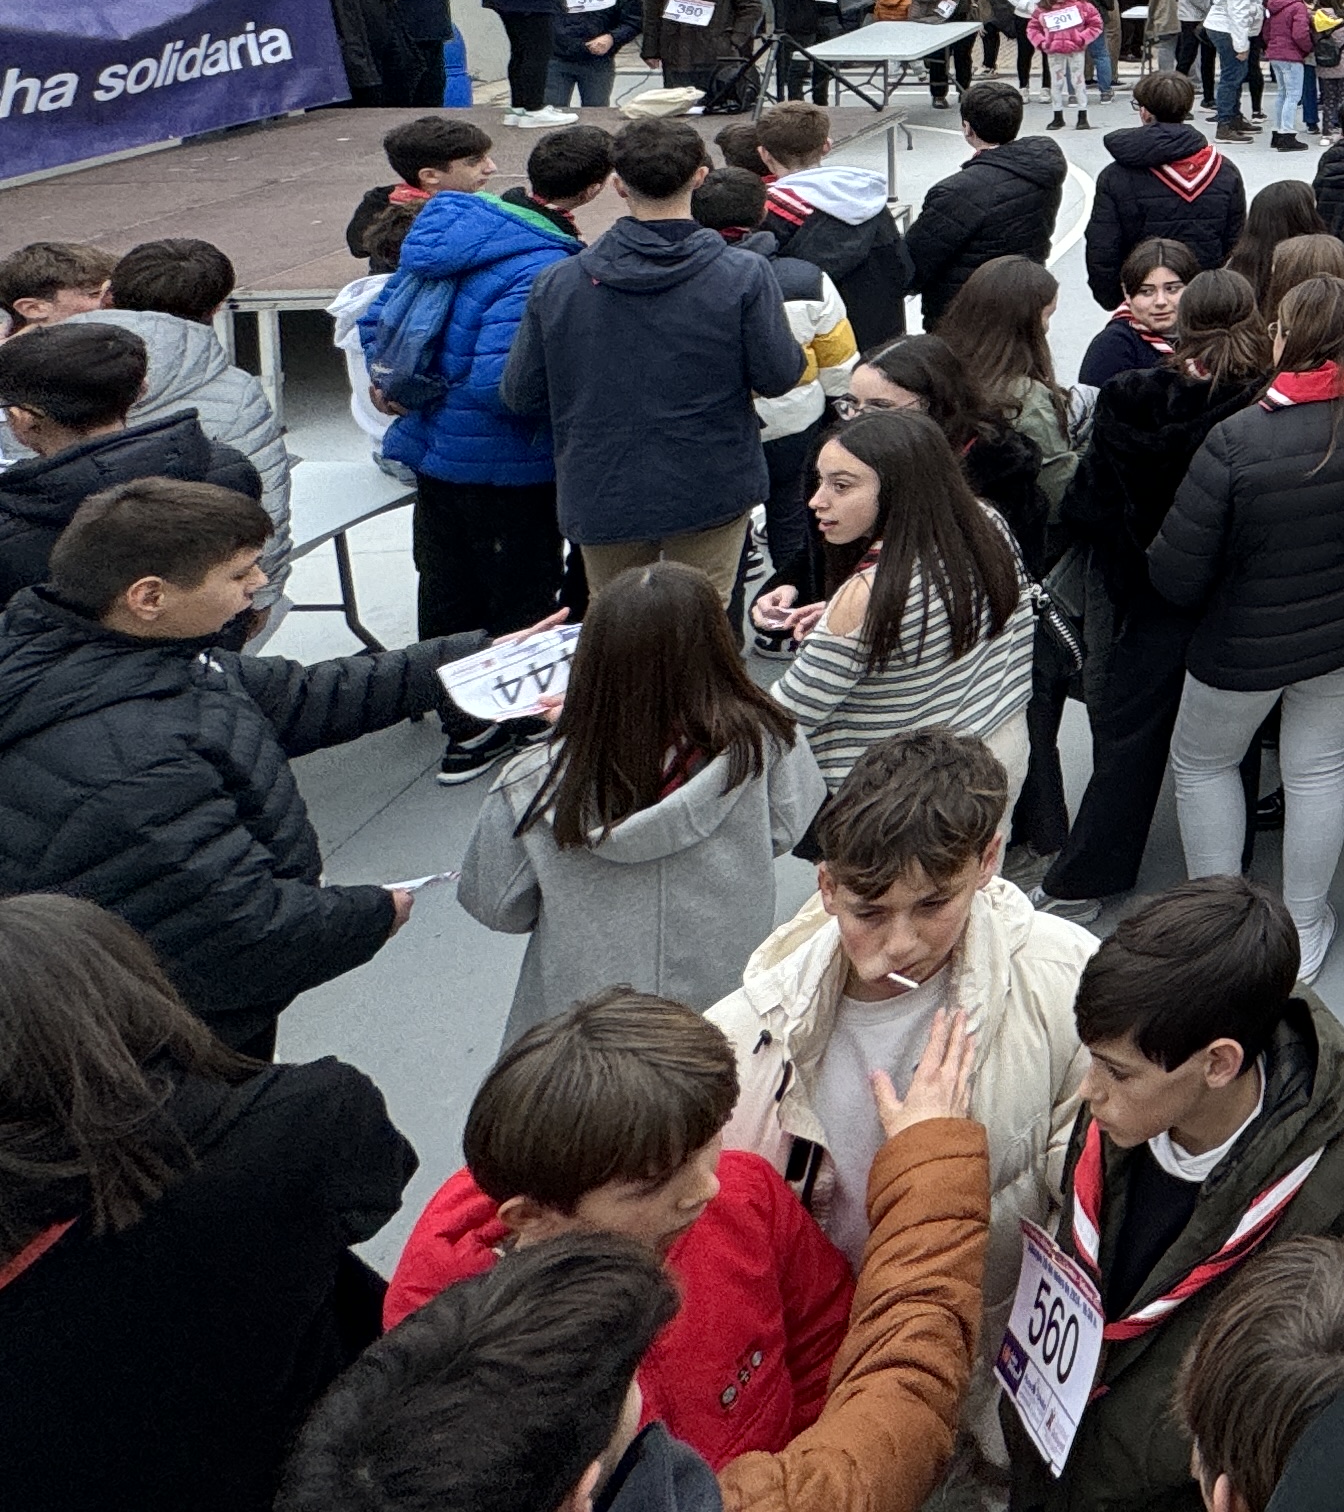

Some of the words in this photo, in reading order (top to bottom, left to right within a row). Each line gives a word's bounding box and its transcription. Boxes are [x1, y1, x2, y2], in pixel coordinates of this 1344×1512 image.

[676, 3, 703, 17] 380
[1053, 13, 1073, 26] 201
[93, 21, 294, 102] solidaria
[1027, 1276, 1080, 1385] 560
